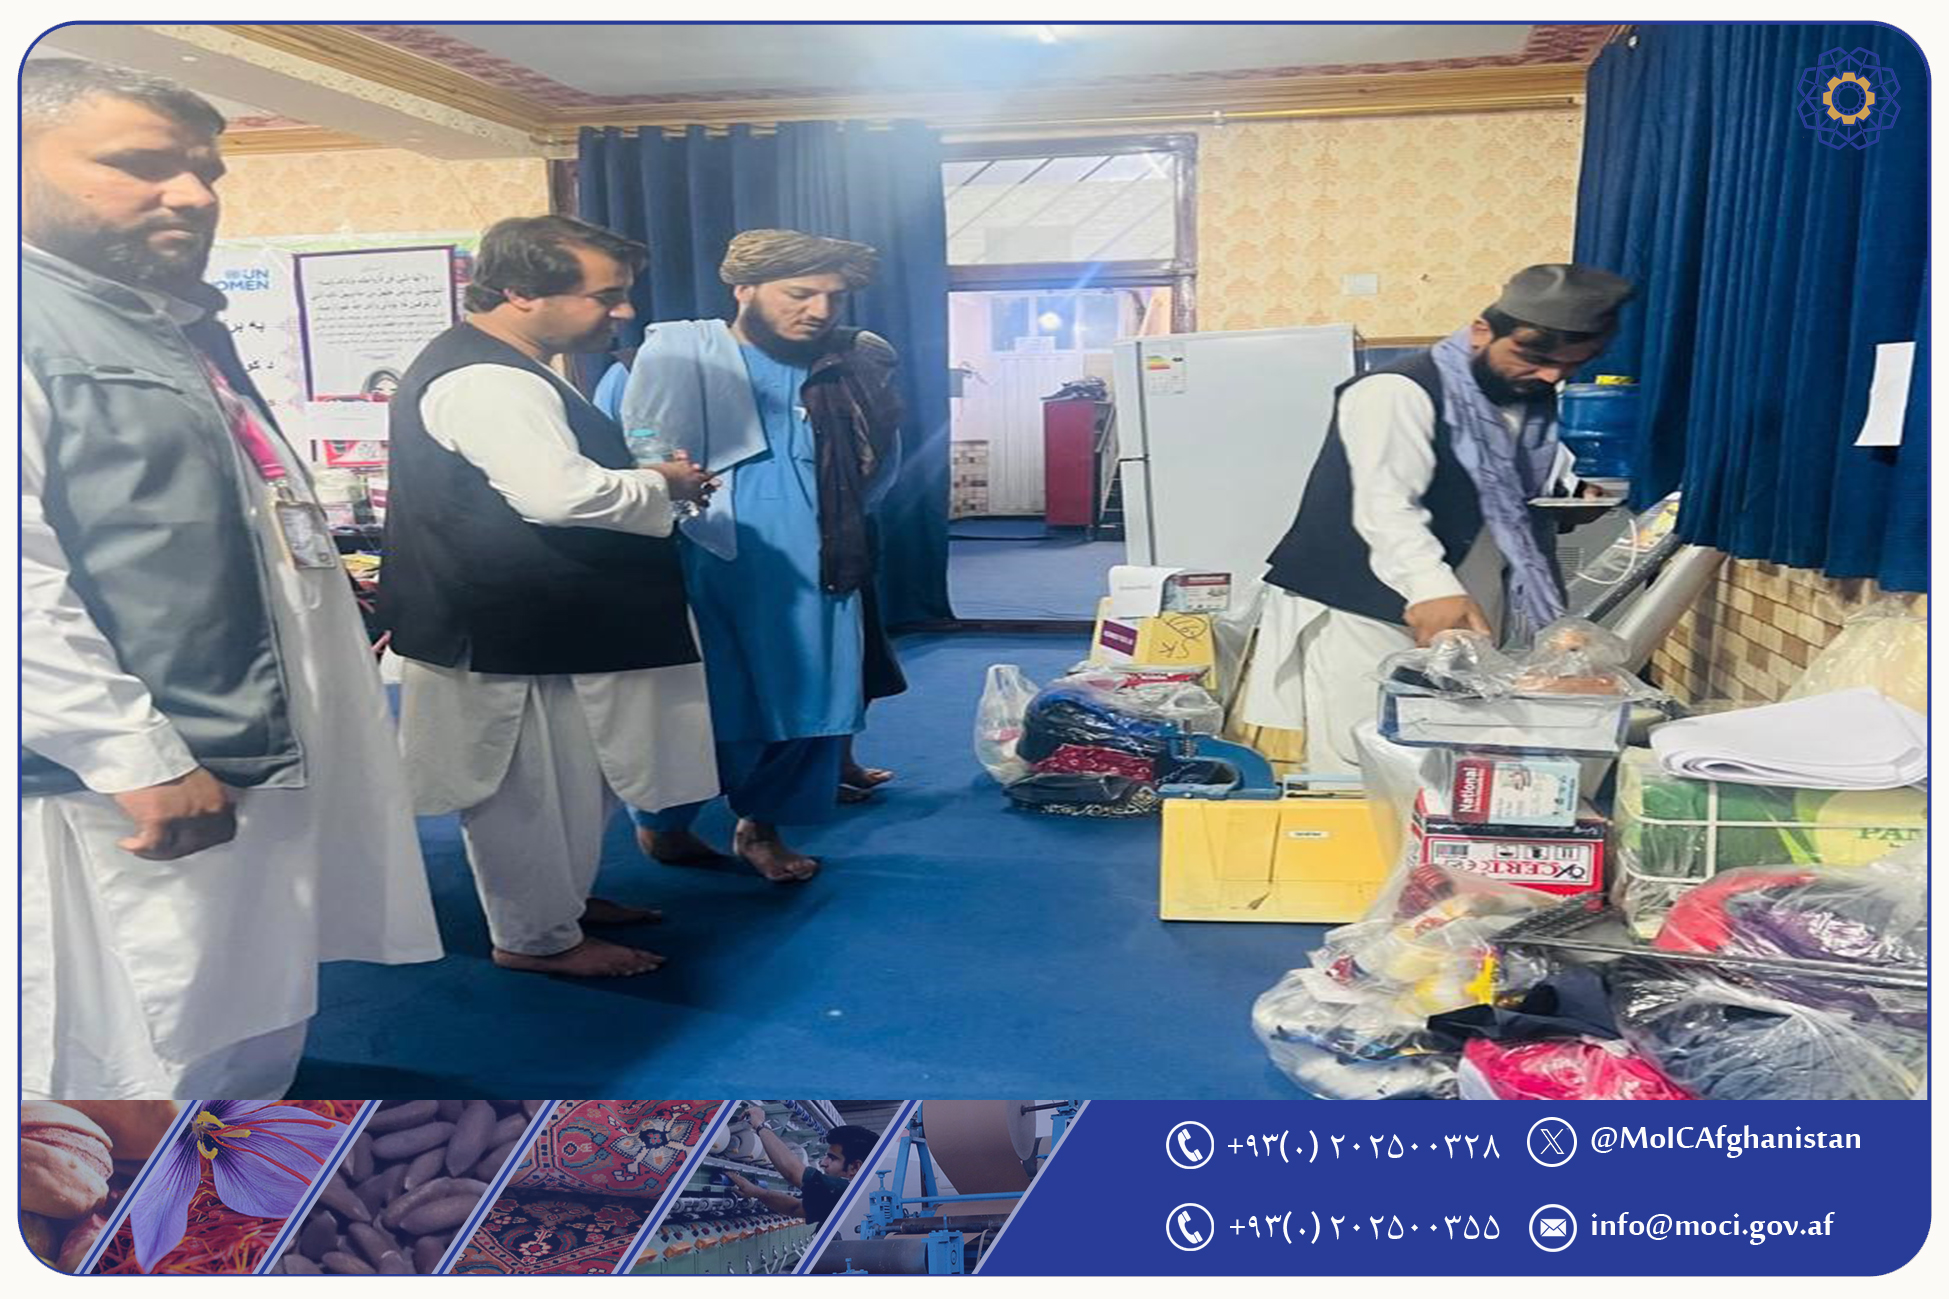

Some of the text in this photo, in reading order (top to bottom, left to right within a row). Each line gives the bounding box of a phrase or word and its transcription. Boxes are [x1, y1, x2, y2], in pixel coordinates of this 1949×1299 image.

[243, 269, 269, 280] UN
[214, 280, 270, 291] OMEN
[1458, 766, 1479, 813] National
